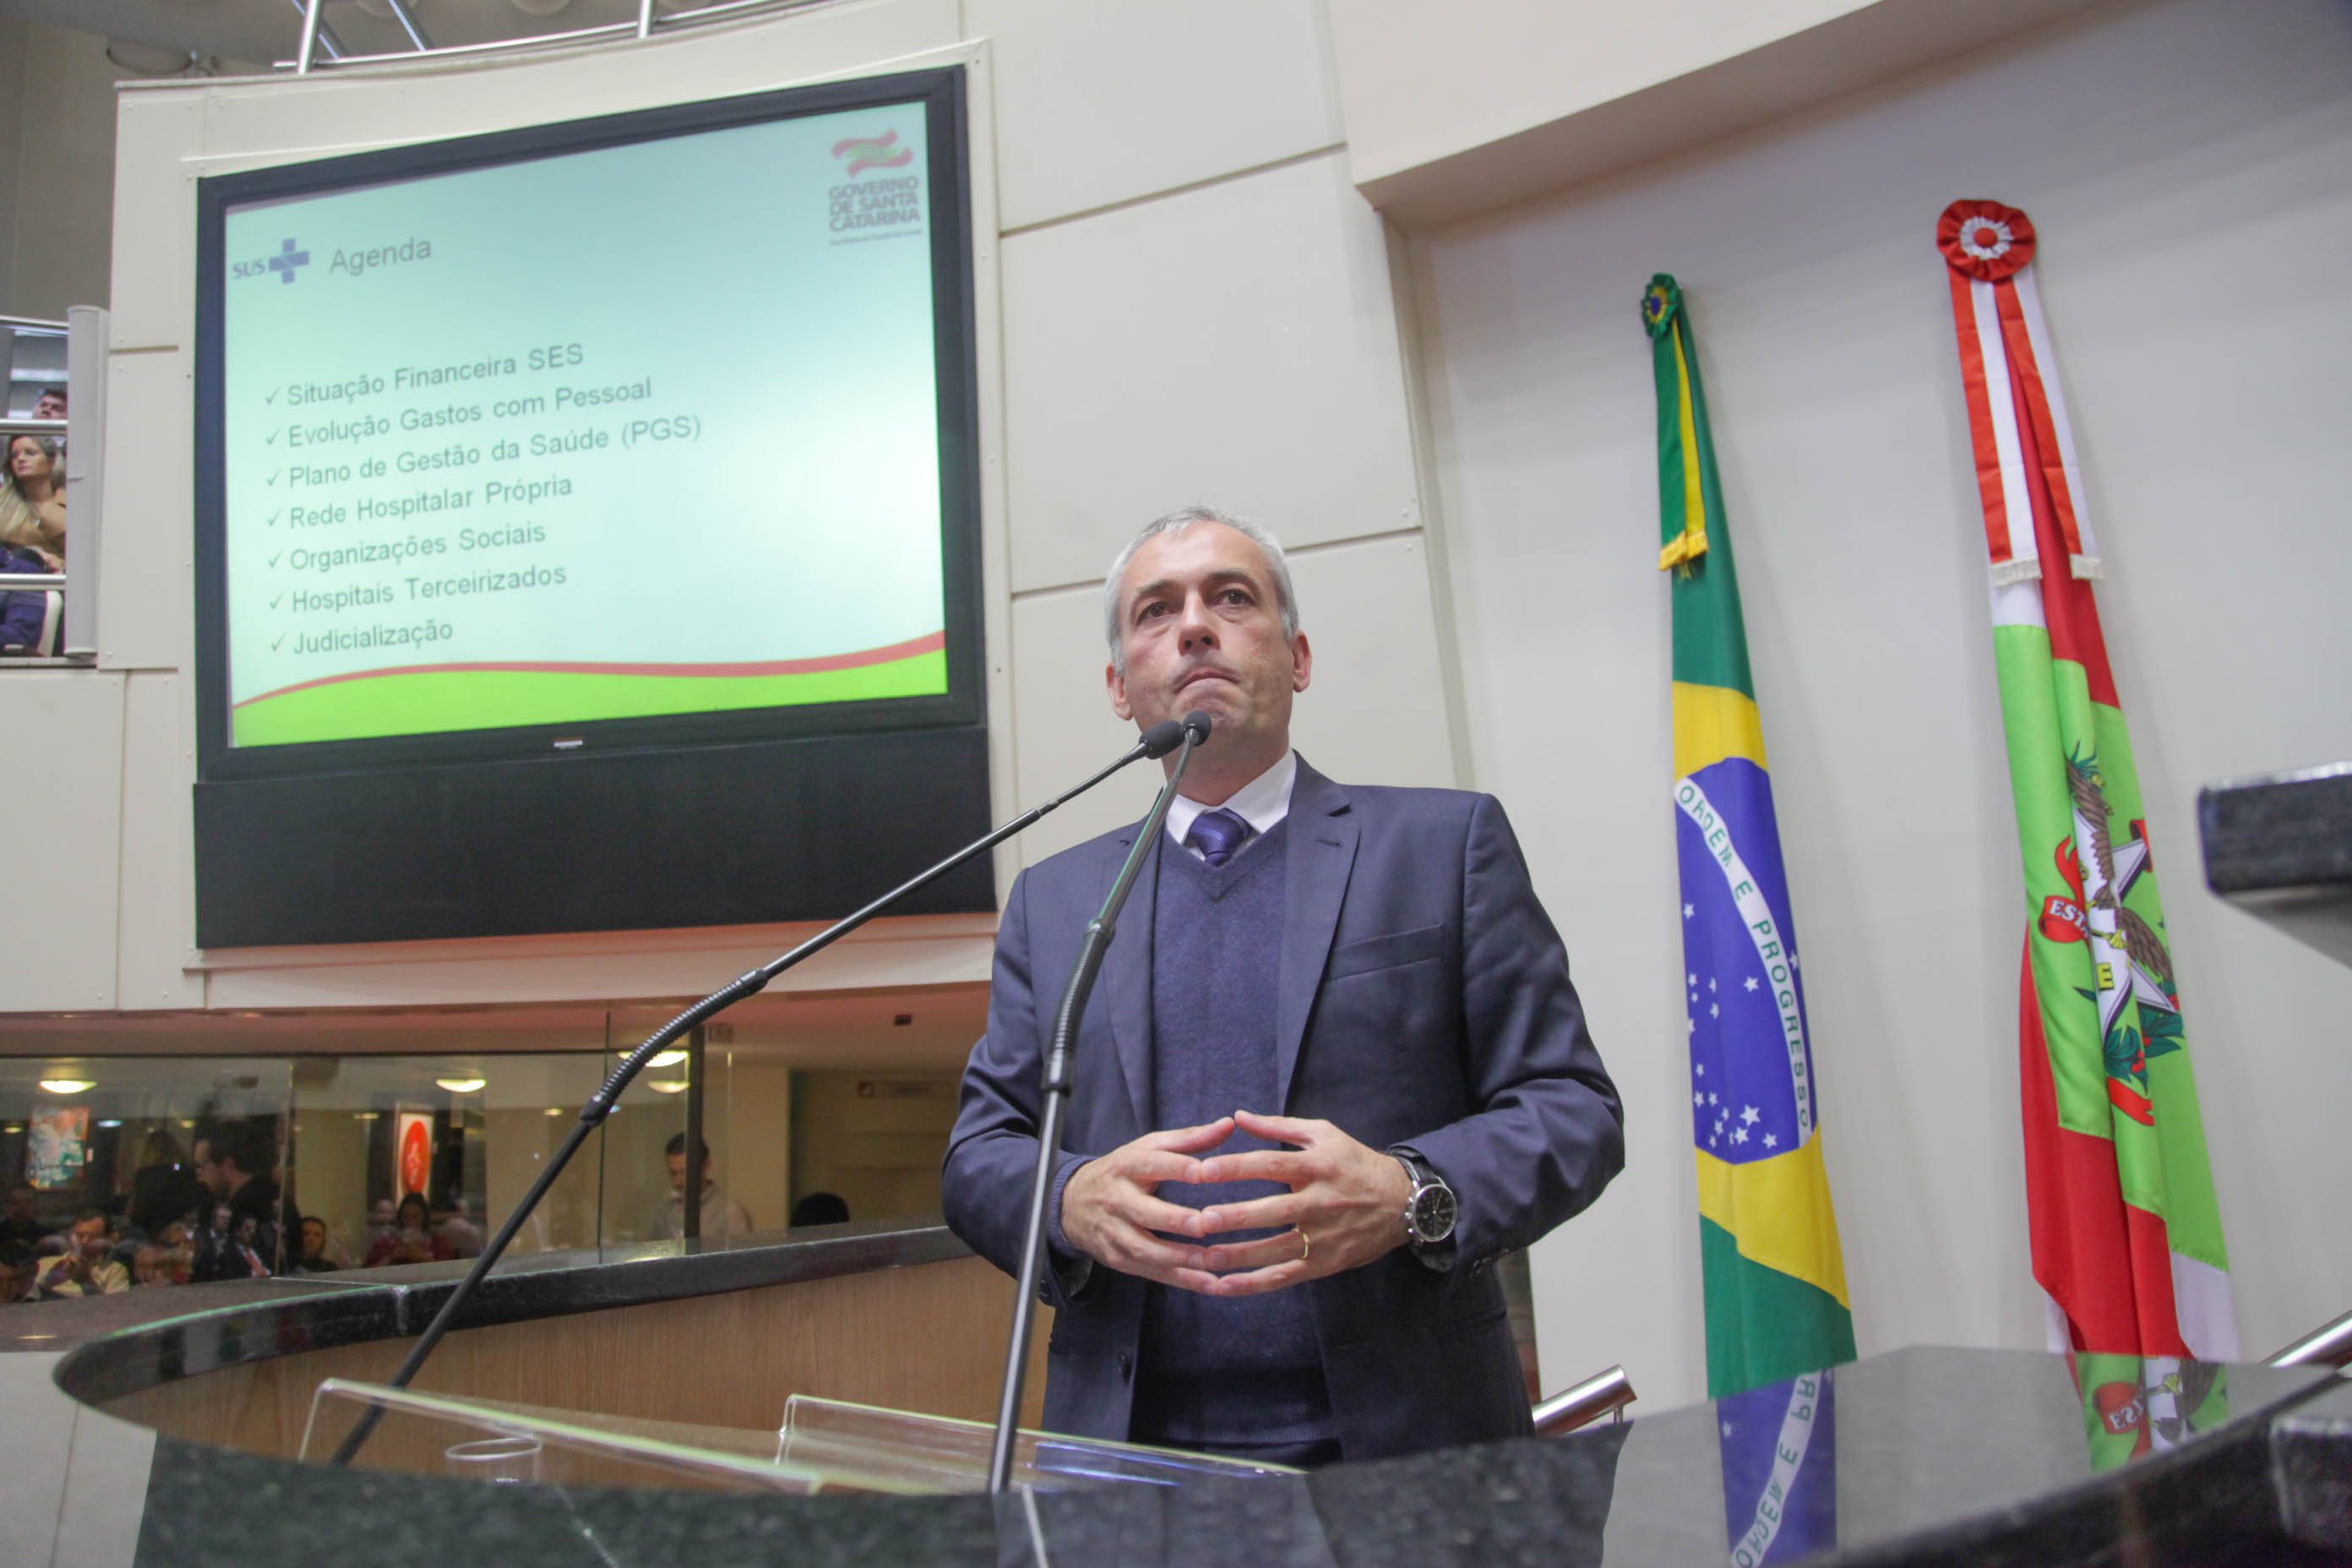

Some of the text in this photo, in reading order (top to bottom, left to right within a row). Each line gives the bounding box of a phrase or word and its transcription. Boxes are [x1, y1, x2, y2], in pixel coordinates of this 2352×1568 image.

[830, 176, 918, 199] GOVERNO
[830, 192, 919, 217] DE SANTA
[830, 208, 921, 232] CATARINA
[232, 259, 265, 280] SUS
[329, 237, 431, 276] Agenda
[288, 342, 583, 406] Situação Financeira SES
[288, 376, 651, 447] Evolução Gastos com Pessoal
[290, 416, 701, 488] Plano de Gestão da Saúde (PGS)
[291, 475, 572, 529] Rede Hospitalar Própria
[291, 520, 546, 573] Organizações Sociais
[292, 564, 567, 612] Hospitais Terceirizados
[293, 618, 453, 654] Judicialização
[1734, 880, 1754, 901] E
[1752, 919, 1809, 1128] PROGRESSO
